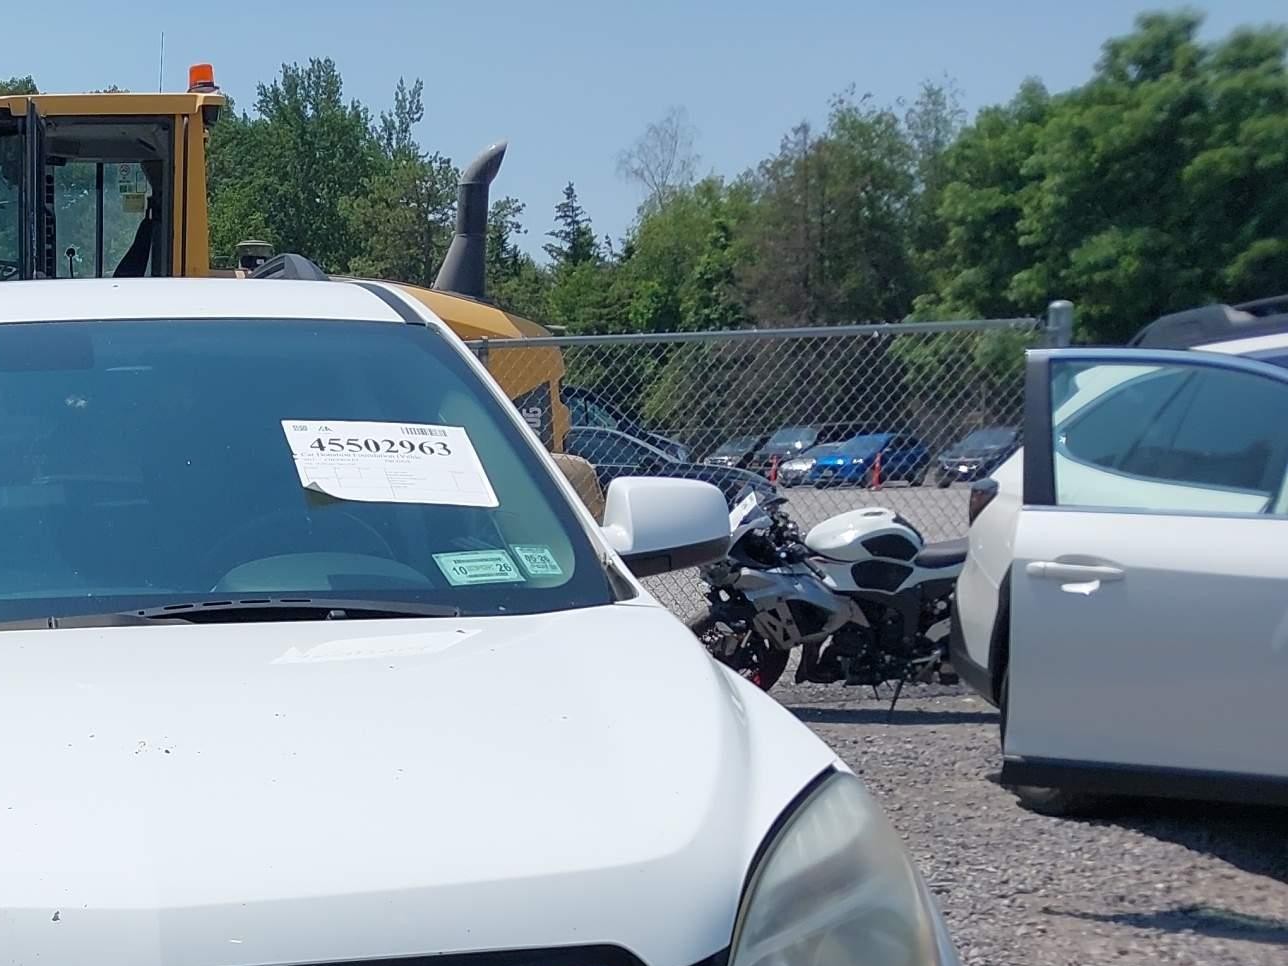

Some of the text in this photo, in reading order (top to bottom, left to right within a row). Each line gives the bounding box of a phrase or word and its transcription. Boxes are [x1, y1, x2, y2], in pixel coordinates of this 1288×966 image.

[309, 437, 452, 457] 45502963
[452, 565, 469, 576] 10
[495, 562, 513, 573] 26
